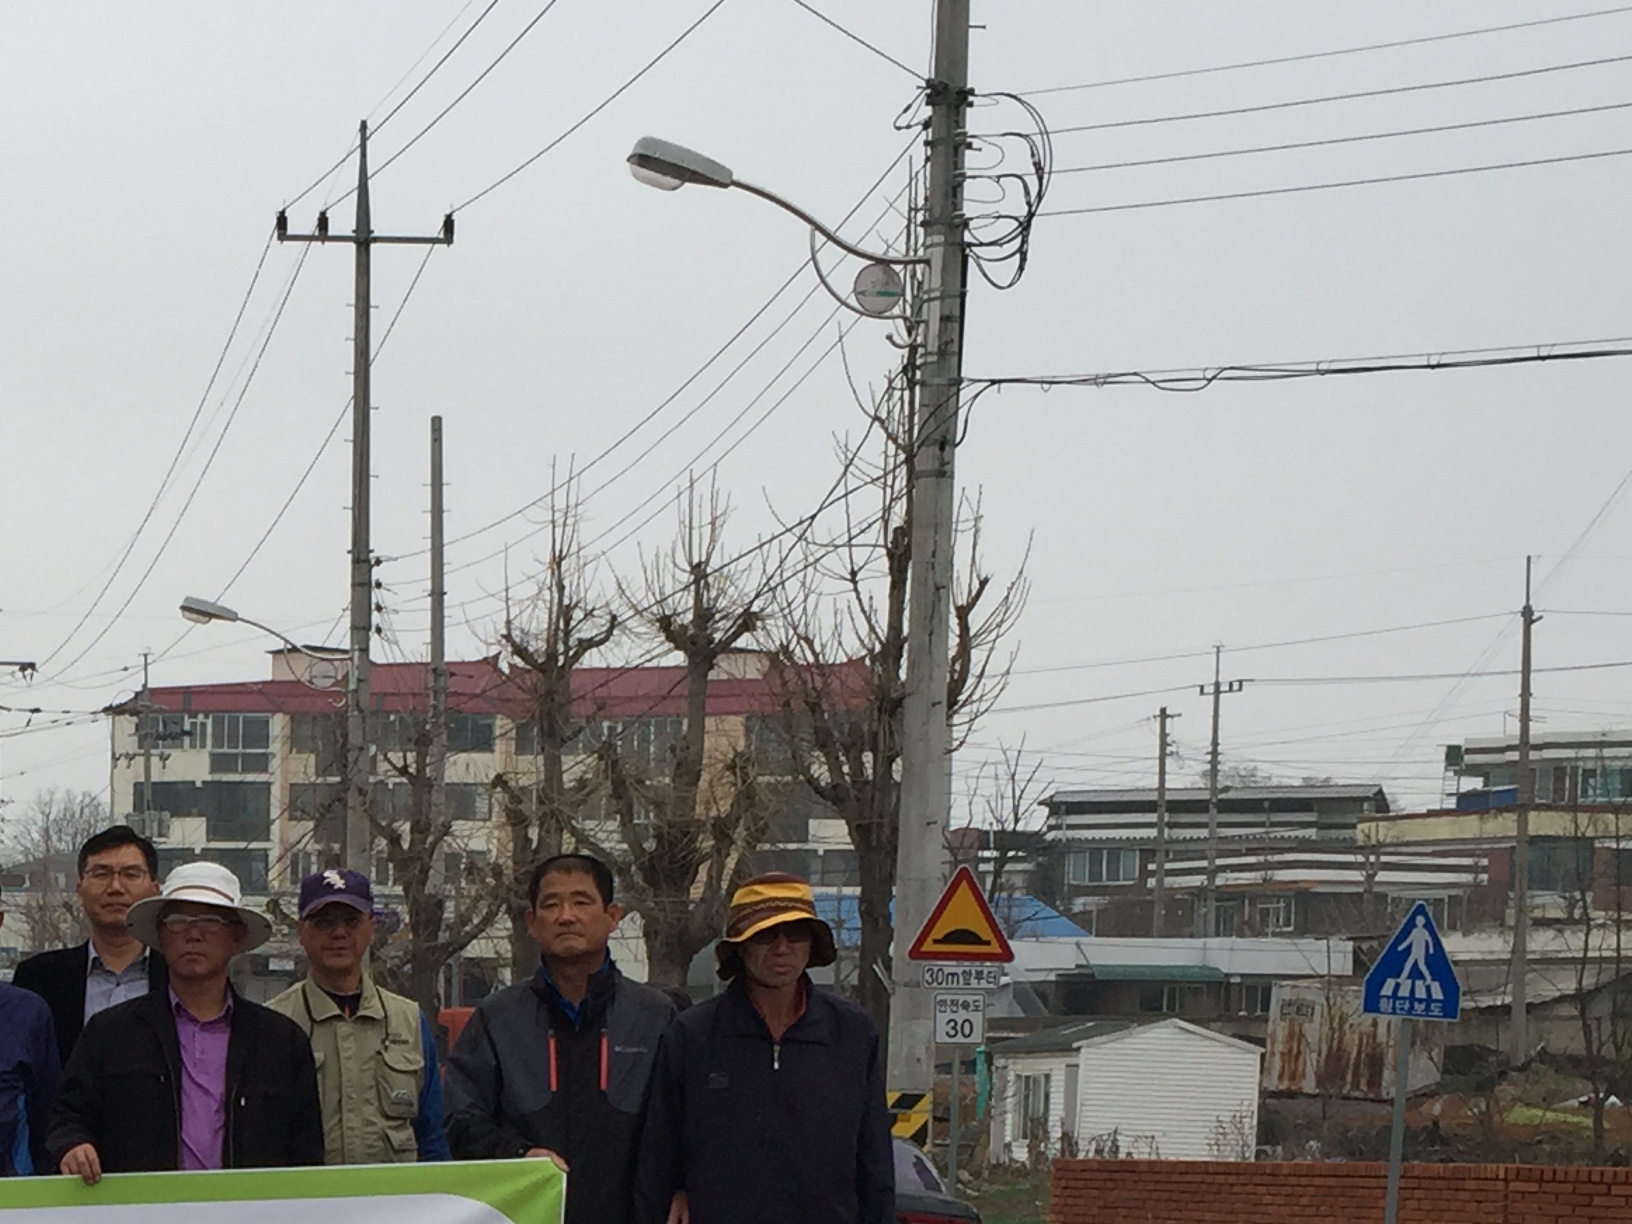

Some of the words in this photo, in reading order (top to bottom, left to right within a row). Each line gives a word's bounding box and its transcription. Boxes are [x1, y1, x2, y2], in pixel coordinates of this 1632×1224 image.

[937, 999, 983, 1013] 안전속도
[1378, 998, 1444, 1016] 횡단보도
[945, 1018, 974, 1039] 30
